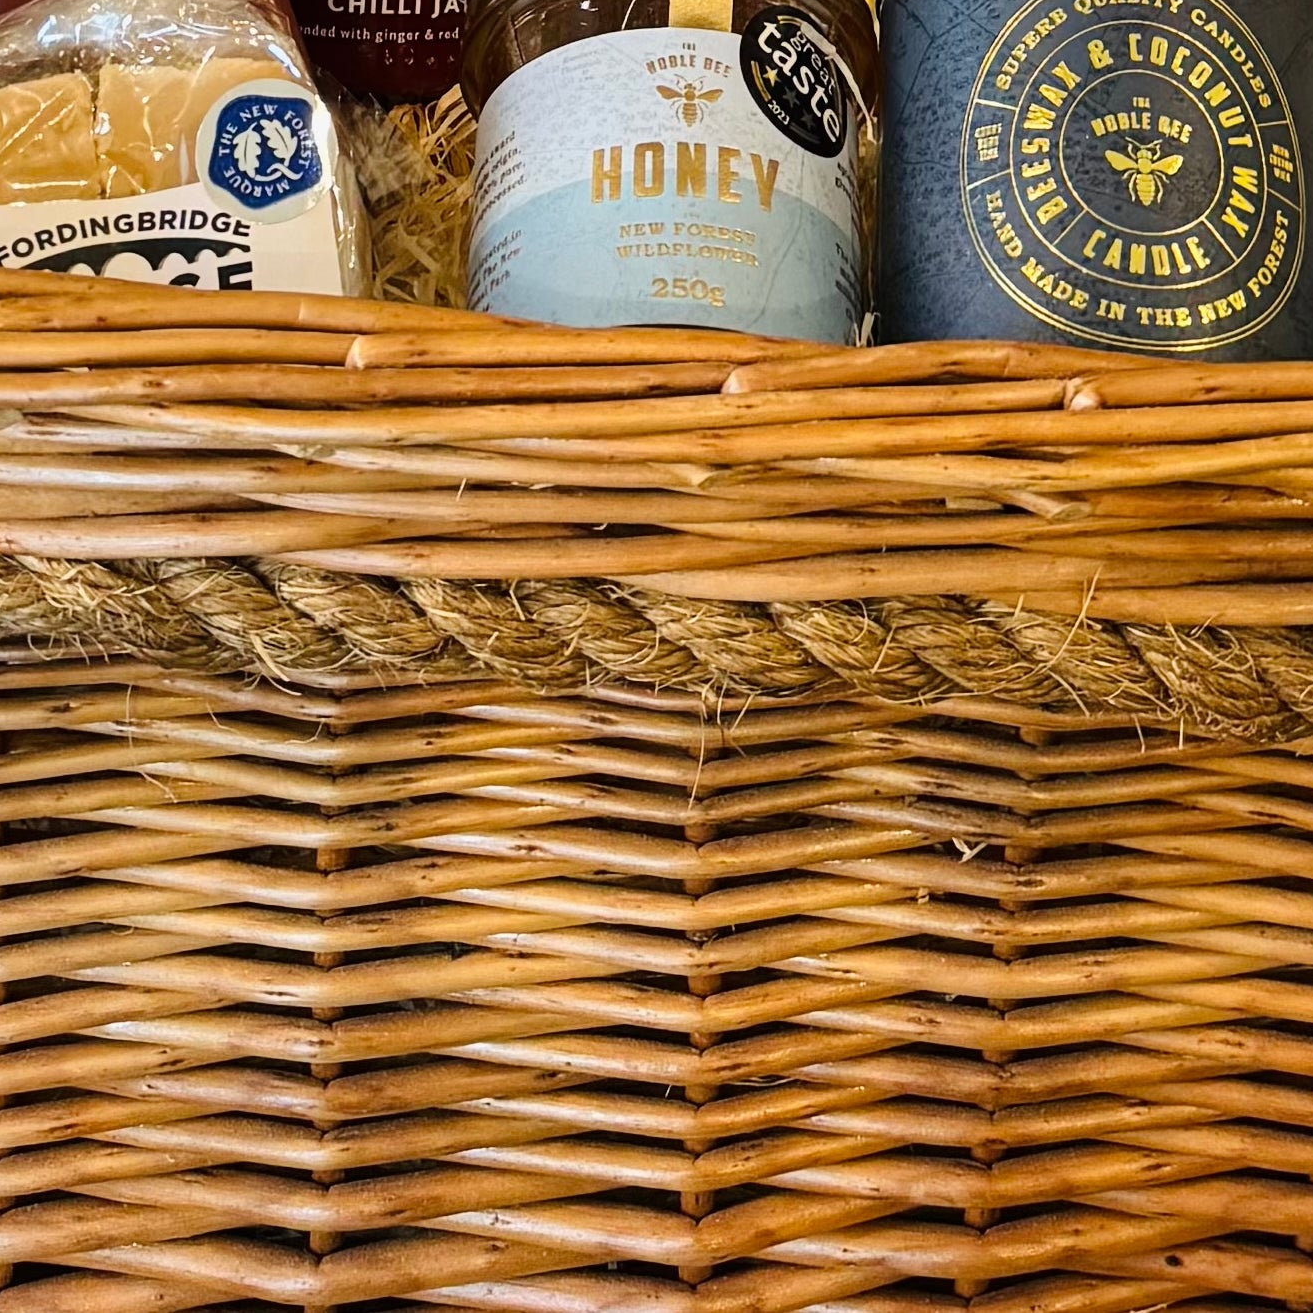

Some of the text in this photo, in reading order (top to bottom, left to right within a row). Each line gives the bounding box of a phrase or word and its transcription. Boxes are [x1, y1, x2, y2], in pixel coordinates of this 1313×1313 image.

[1190, 8, 1272, 110] CANDLES
[591, 141, 781, 213] HONEY
[1083, 229, 1211, 276] CANDLE
[651, 278, 726, 307] 250g
